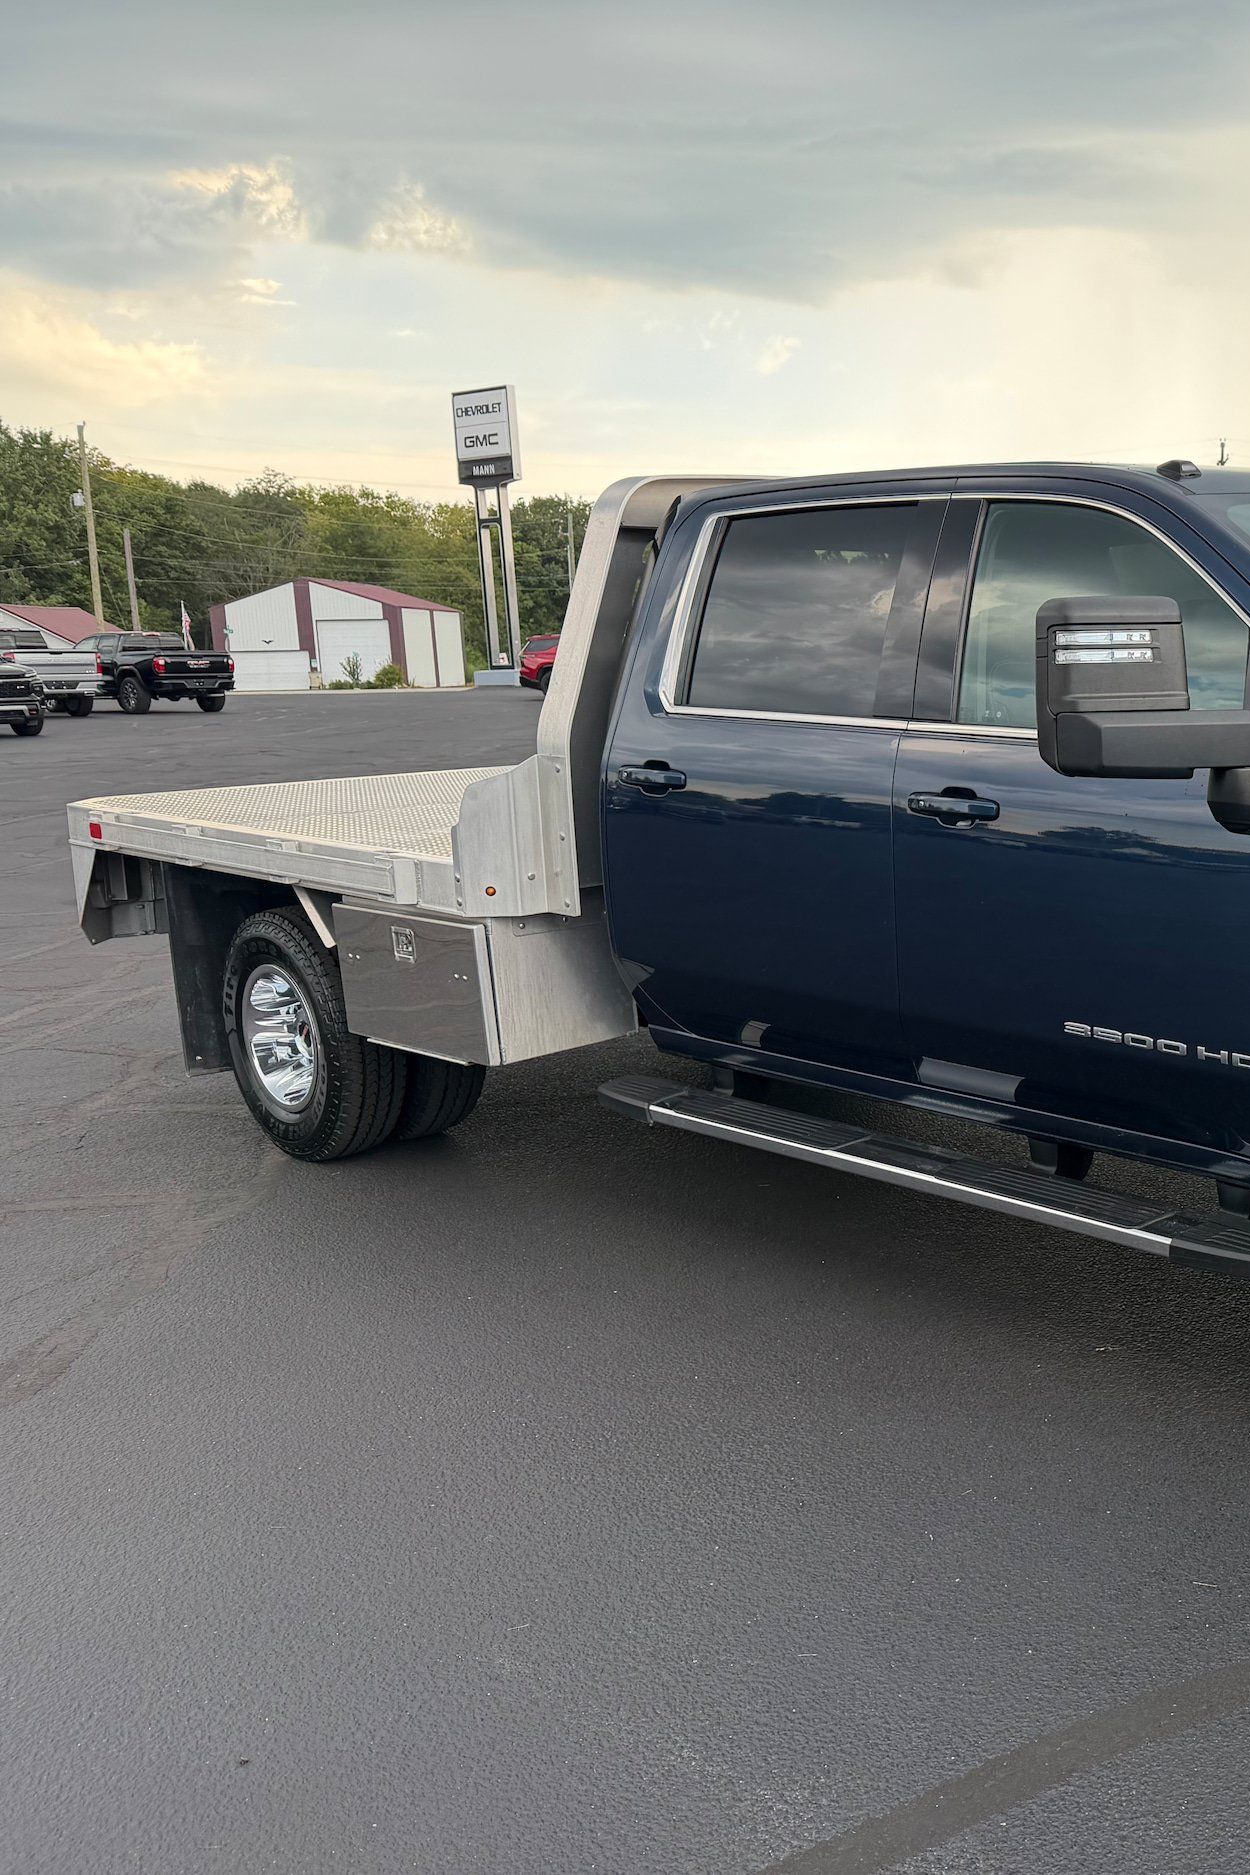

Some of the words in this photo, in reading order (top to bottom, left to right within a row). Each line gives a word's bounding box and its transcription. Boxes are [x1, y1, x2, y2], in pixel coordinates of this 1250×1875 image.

[455, 402, 502, 418] CHEVROLET
[464, 433, 499, 449] GMC
[472, 464, 496, 476] MANN
[1063, 1021, 1187, 1056] 3500
